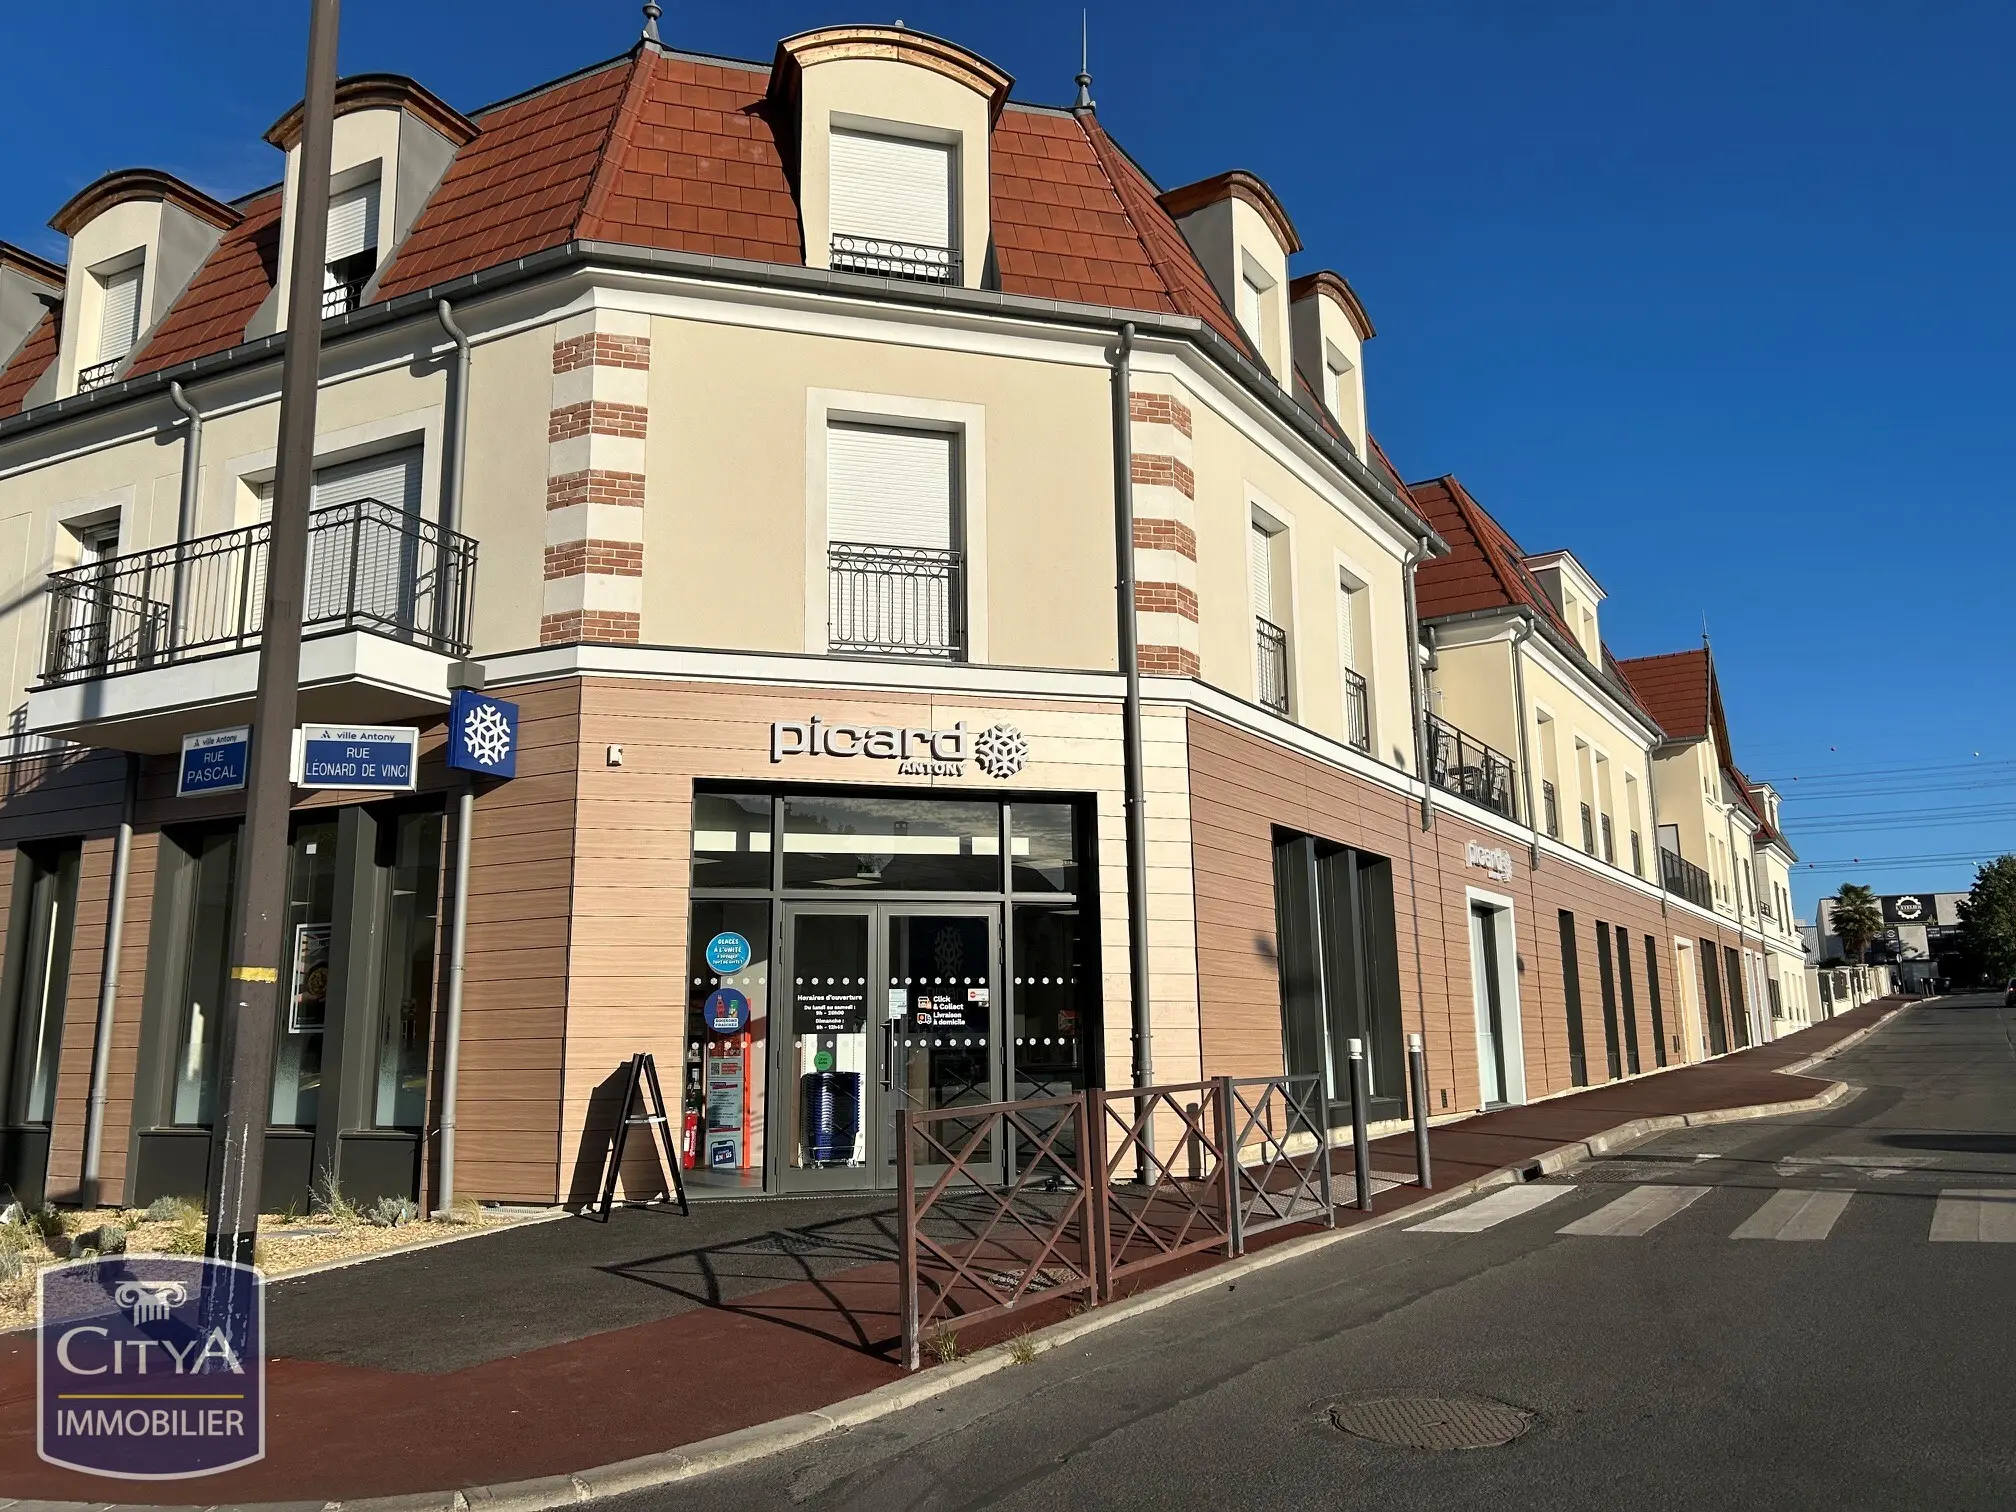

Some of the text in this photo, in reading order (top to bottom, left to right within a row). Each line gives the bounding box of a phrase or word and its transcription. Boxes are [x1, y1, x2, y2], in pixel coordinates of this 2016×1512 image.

[202, 734, 238, 745] ville Antony
[337, 732, 395, 742] ville Antony
[770, 714, 967, 763] picard
[203, 750, 225, 763] RUE
[346, 747, 370, 758] RUE
[186, 764, 237, 784] PASCAL
[306, 759, 408, 778] LÉONARD DE VINCI
[898, 762, 967, 777] ANTONY
[933, 995, 951, 1003] Click
[938, 1018, 966, 1026] domicile
